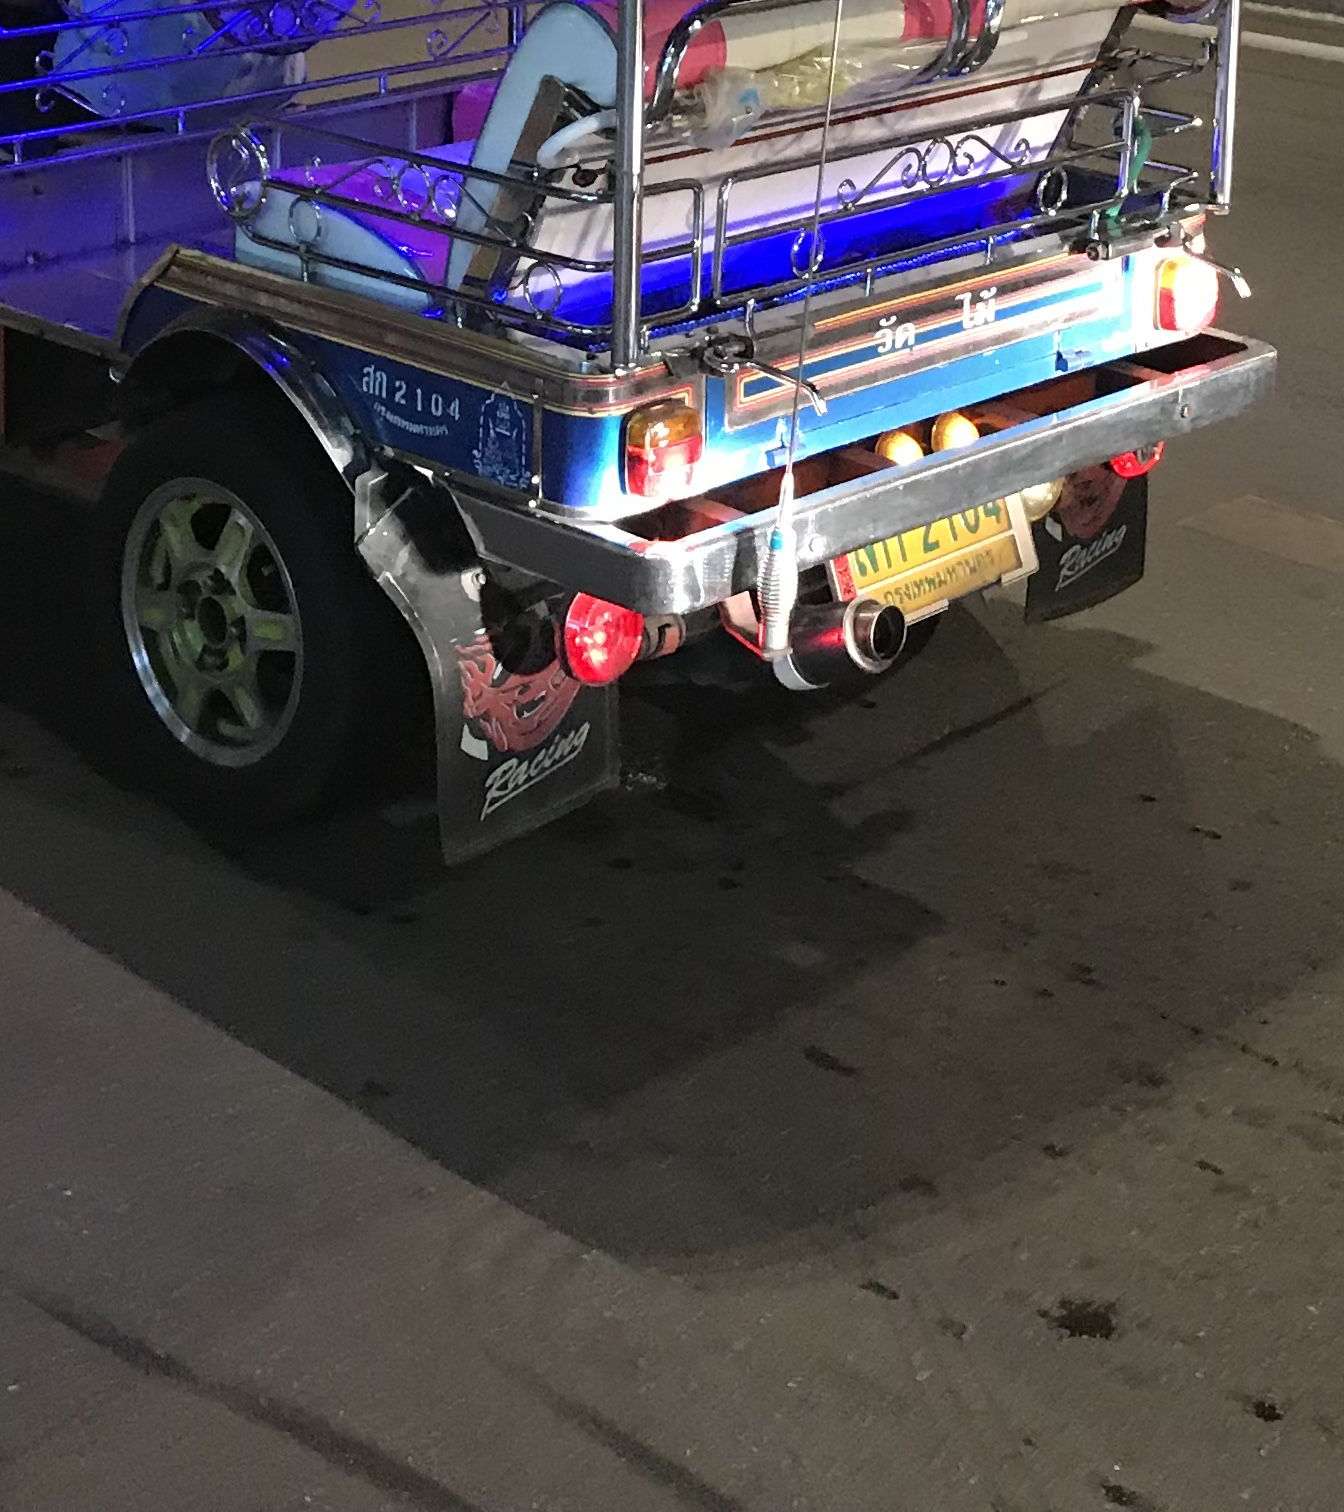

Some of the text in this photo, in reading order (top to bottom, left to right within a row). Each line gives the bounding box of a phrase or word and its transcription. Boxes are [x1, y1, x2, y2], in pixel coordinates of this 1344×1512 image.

[394, 380, 460, 421] 2104
[1055, 524, 1127, 592] Racing
[480, 721, 591, 822] Racing
